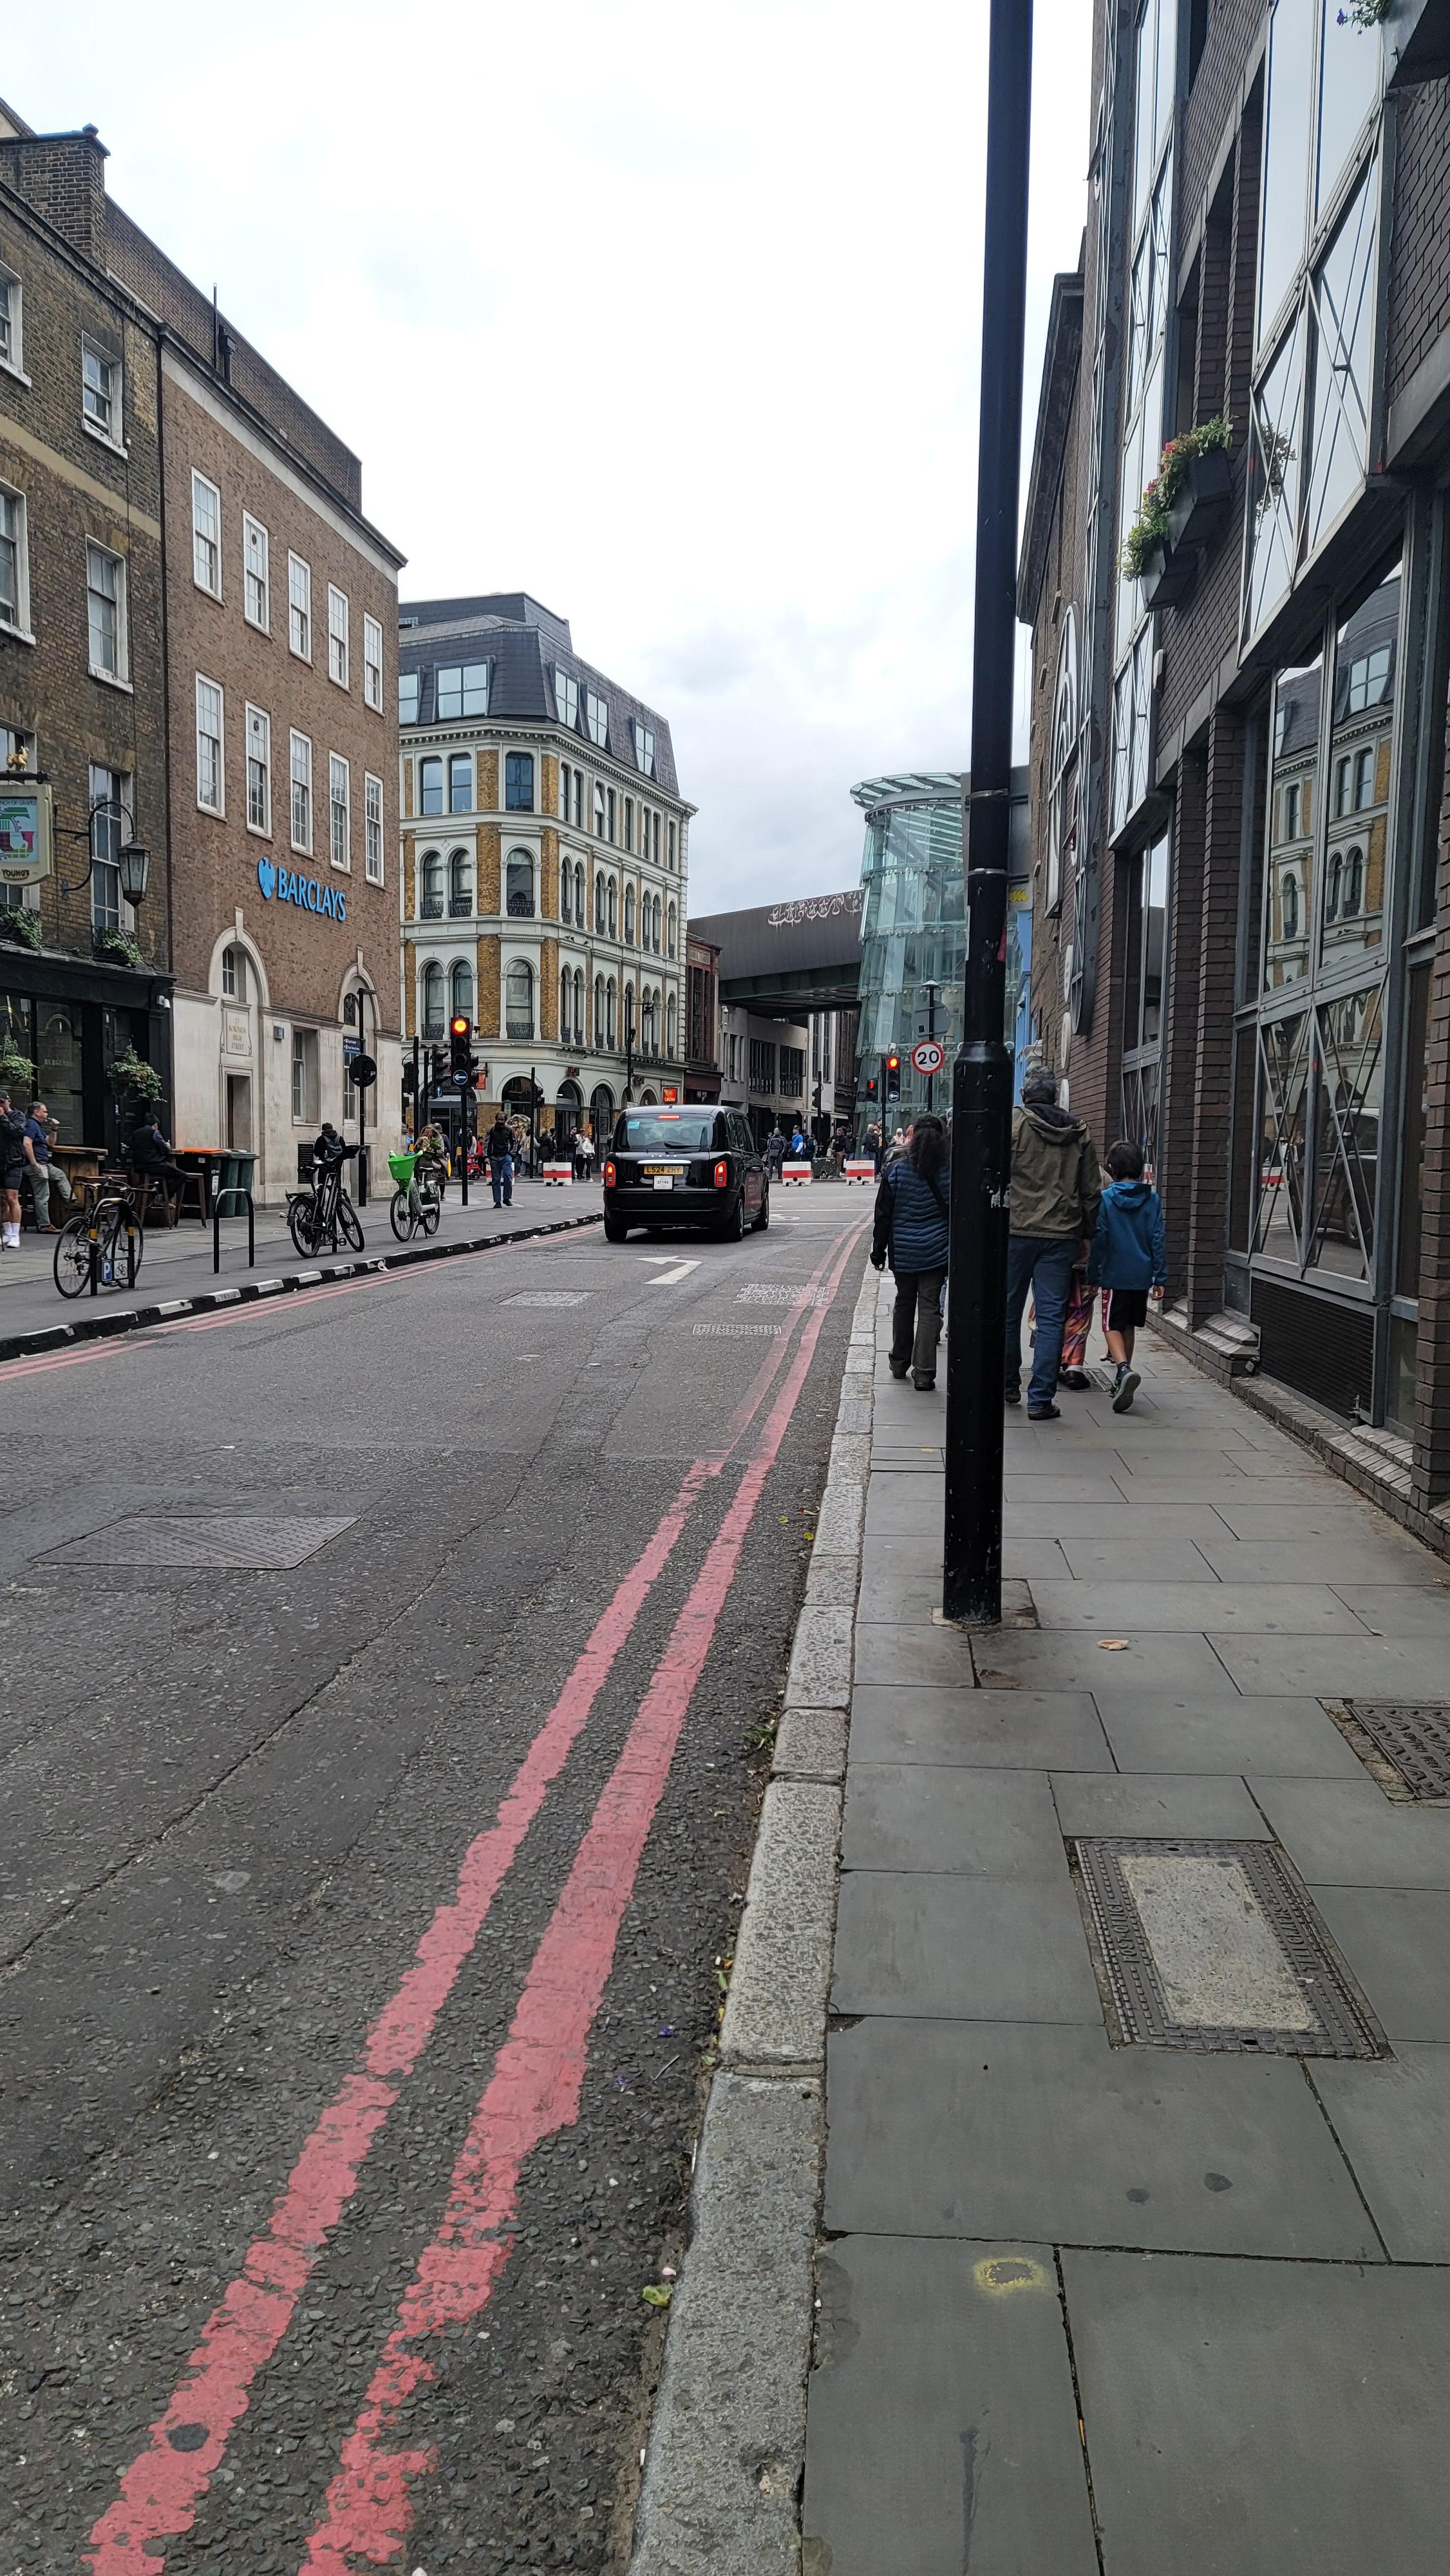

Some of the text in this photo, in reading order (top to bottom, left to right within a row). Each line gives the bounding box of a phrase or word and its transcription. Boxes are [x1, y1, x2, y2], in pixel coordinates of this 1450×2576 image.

[278, 866, 346, 922] BARCLAYS
[918, 1050, 939, 1065] 20
[104, 1262, 110, 1280] P
